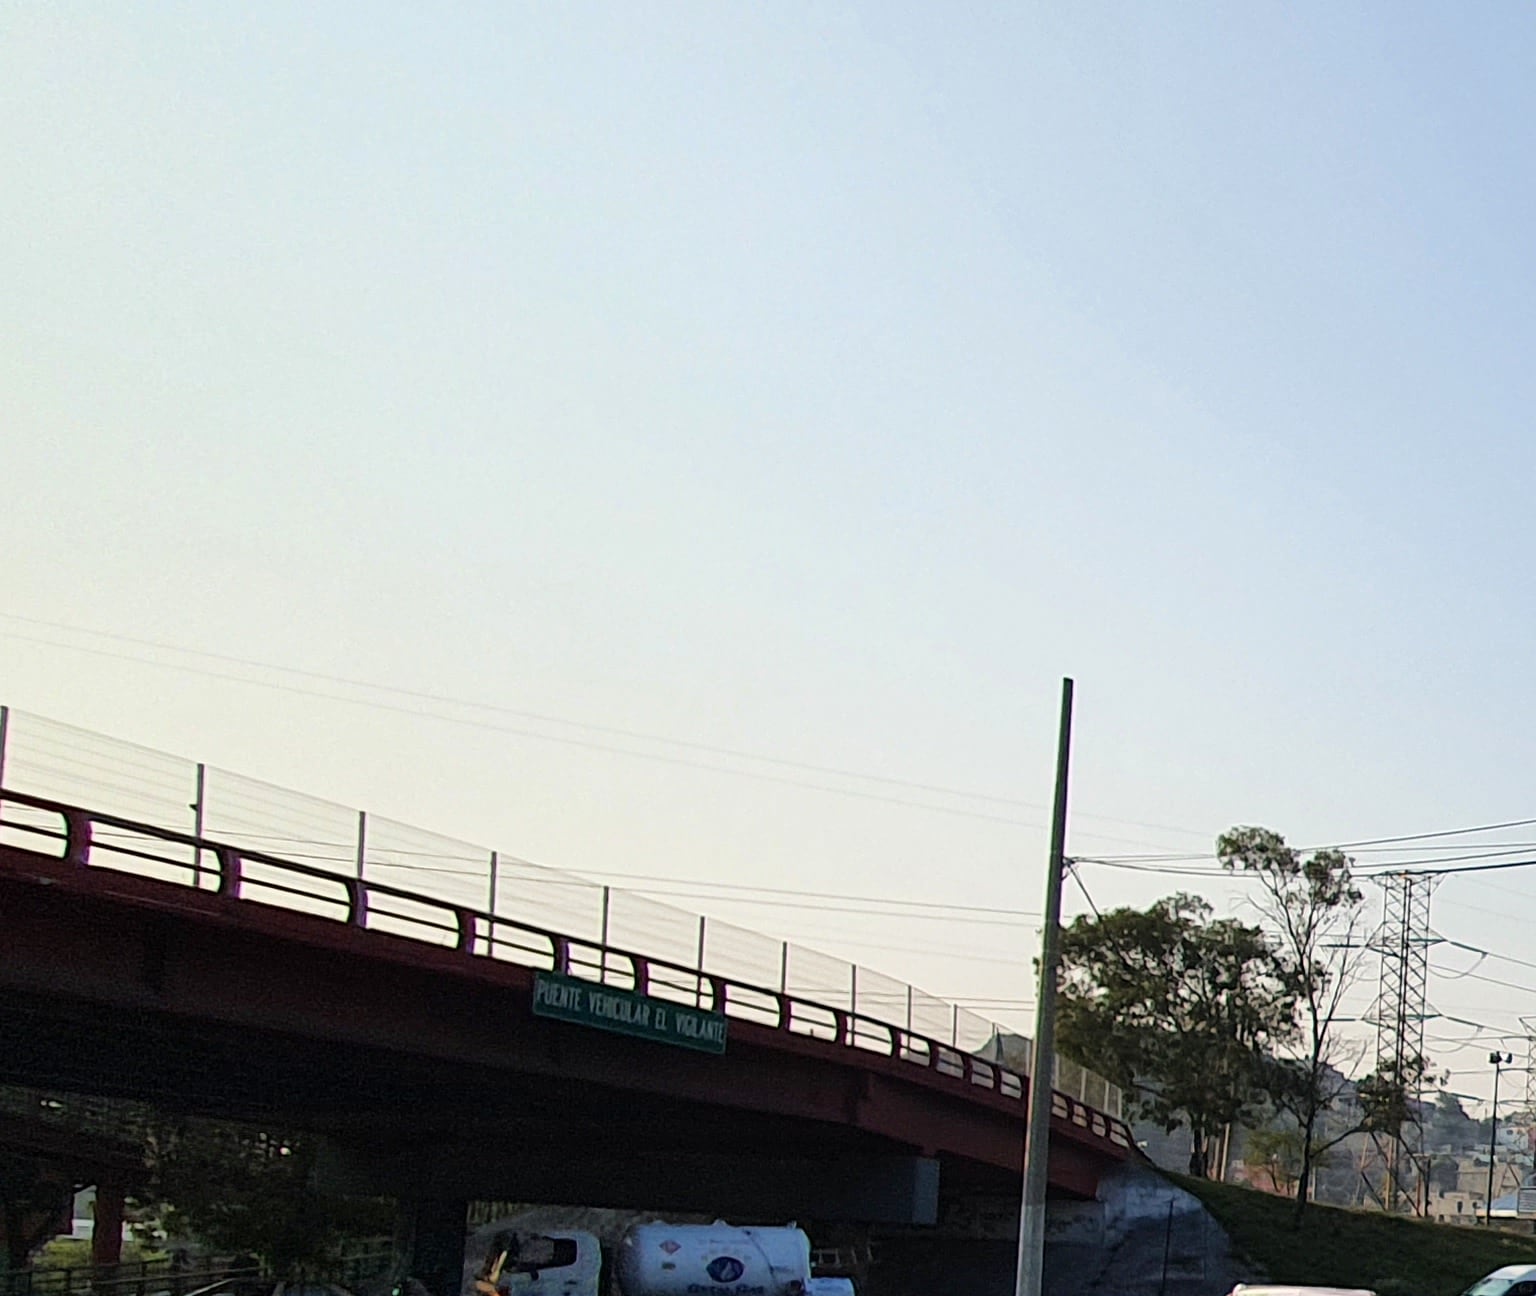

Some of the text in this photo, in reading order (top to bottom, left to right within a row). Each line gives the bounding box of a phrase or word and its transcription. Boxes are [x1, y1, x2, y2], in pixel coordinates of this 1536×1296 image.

[536, 980, 725, 1044] PUENTE VEHICULAR EL VIGILANTE
